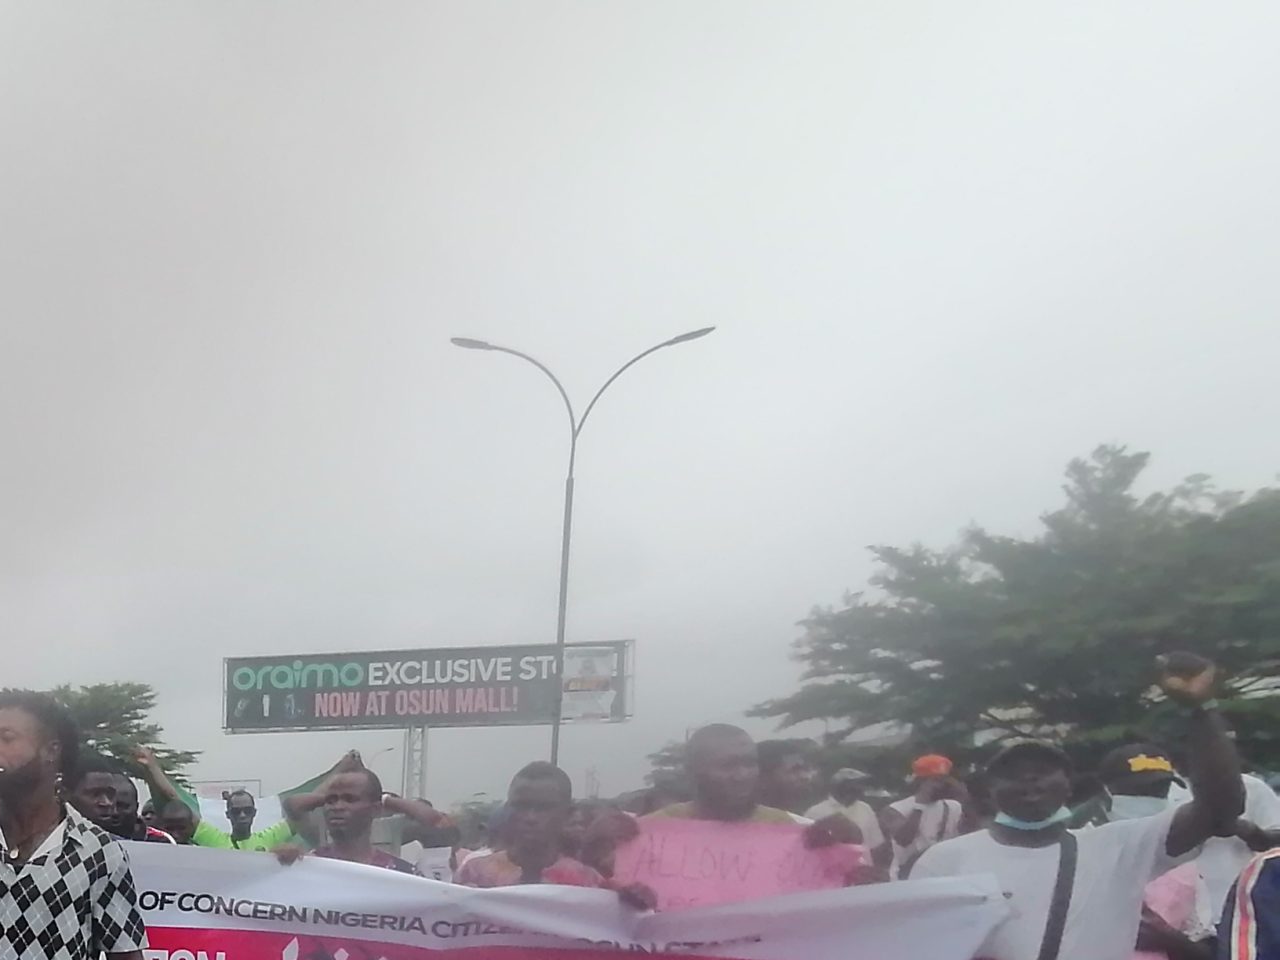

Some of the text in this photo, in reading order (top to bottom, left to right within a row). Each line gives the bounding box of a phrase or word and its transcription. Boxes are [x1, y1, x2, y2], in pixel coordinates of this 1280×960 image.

[233, 655, 557, 690] oraimo EXCLUSIVE ST
[314, 687, 519, 717] NOW AT OSUN MALL!
[139, 890, 176, 912] OF
[177, 894, 307, 924] CONCERN
[314, 907, 428, 936] NIGERIA
